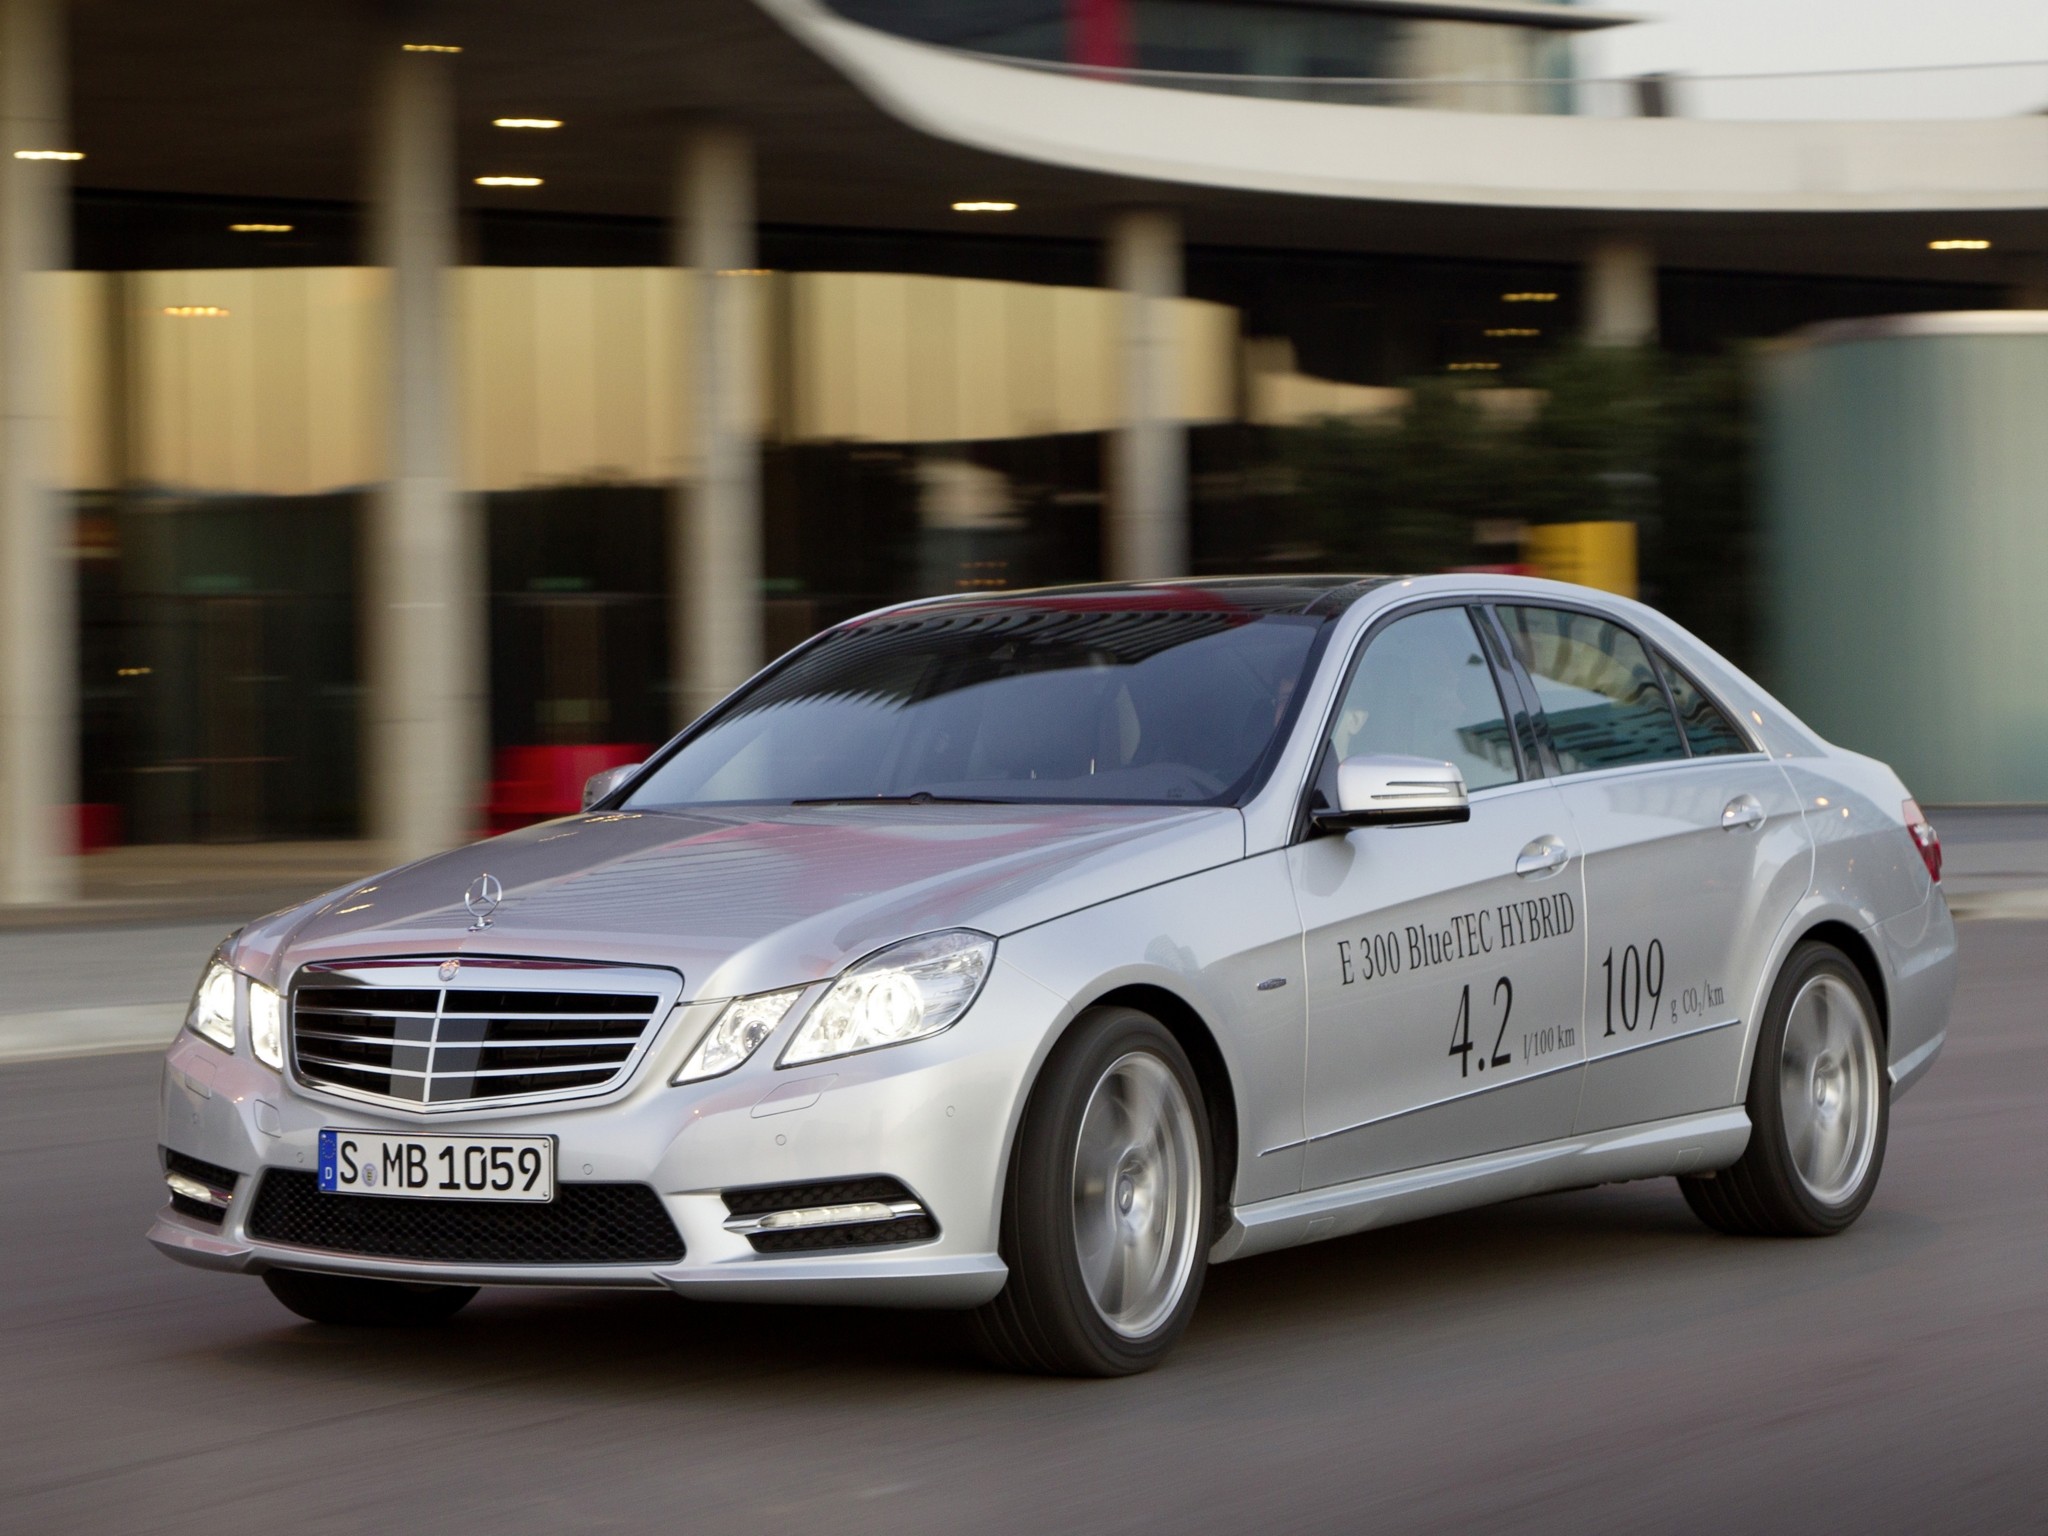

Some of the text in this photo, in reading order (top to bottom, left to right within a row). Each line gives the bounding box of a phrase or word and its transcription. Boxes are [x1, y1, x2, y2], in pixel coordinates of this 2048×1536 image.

[1338, 892, 1574, 985] E 300 BlueTEC HYBRID
[1448, 976, 1513, 1078] 4.2
[1557, 1025, 1575, 1050] km
[1603, 938, 1665, 1037] 109
[1671, 999, 1678, 1024] g
[324, 1166, 333, 1180] D
[340, 1141, 358, 1184] S
